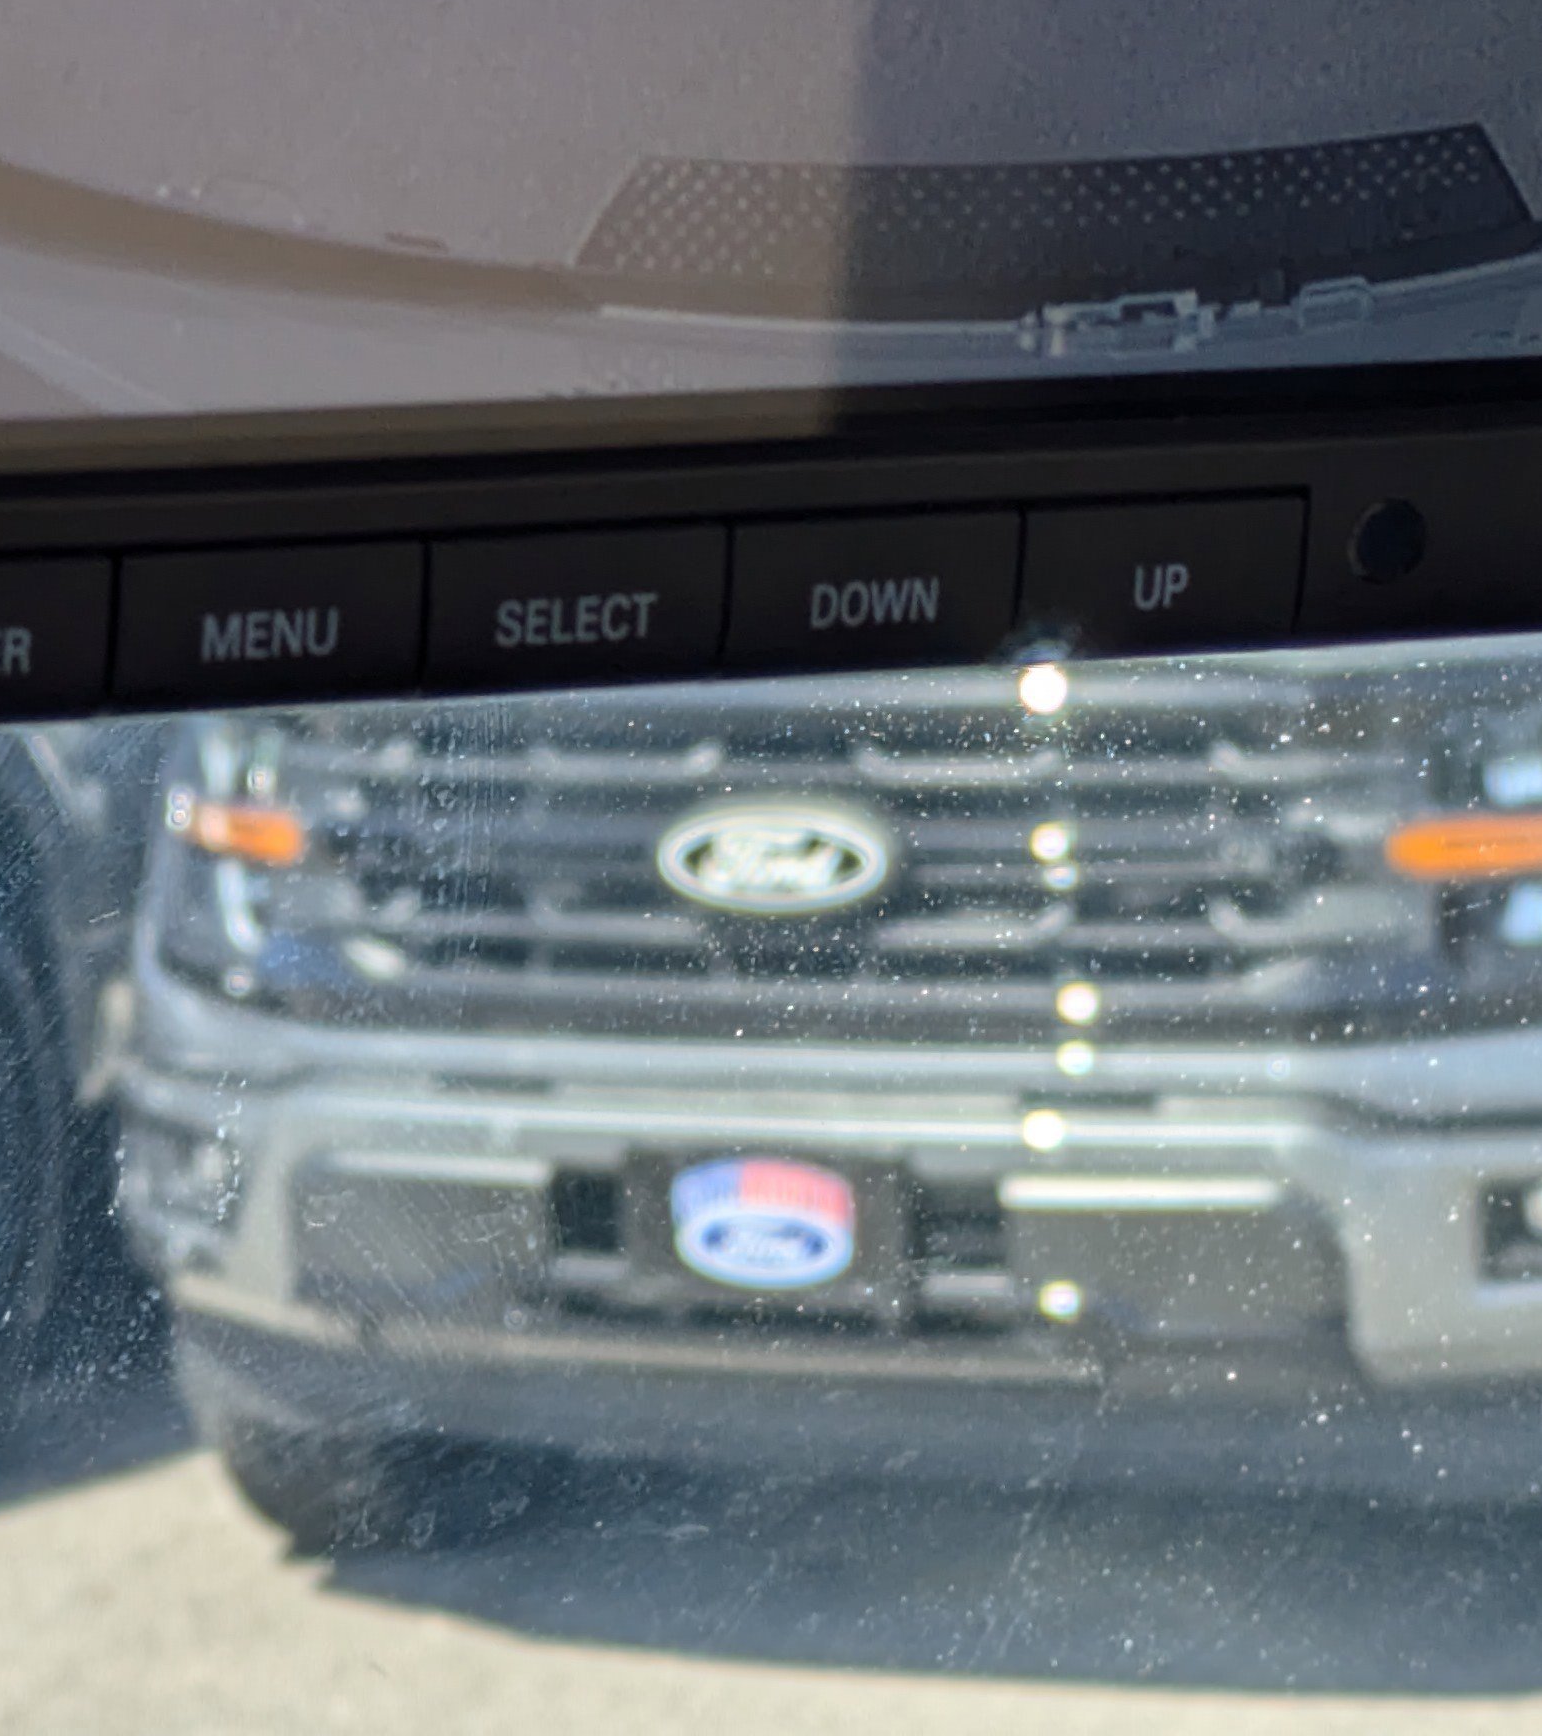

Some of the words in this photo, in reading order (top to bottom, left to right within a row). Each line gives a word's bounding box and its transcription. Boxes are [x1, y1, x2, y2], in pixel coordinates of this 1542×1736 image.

[809, 576, 941, 631] DOWN
[1133, 563, 1190, 611] UP
[200, 606, 340, 663] MENU
[494, 591, 658, 648] SELECT
